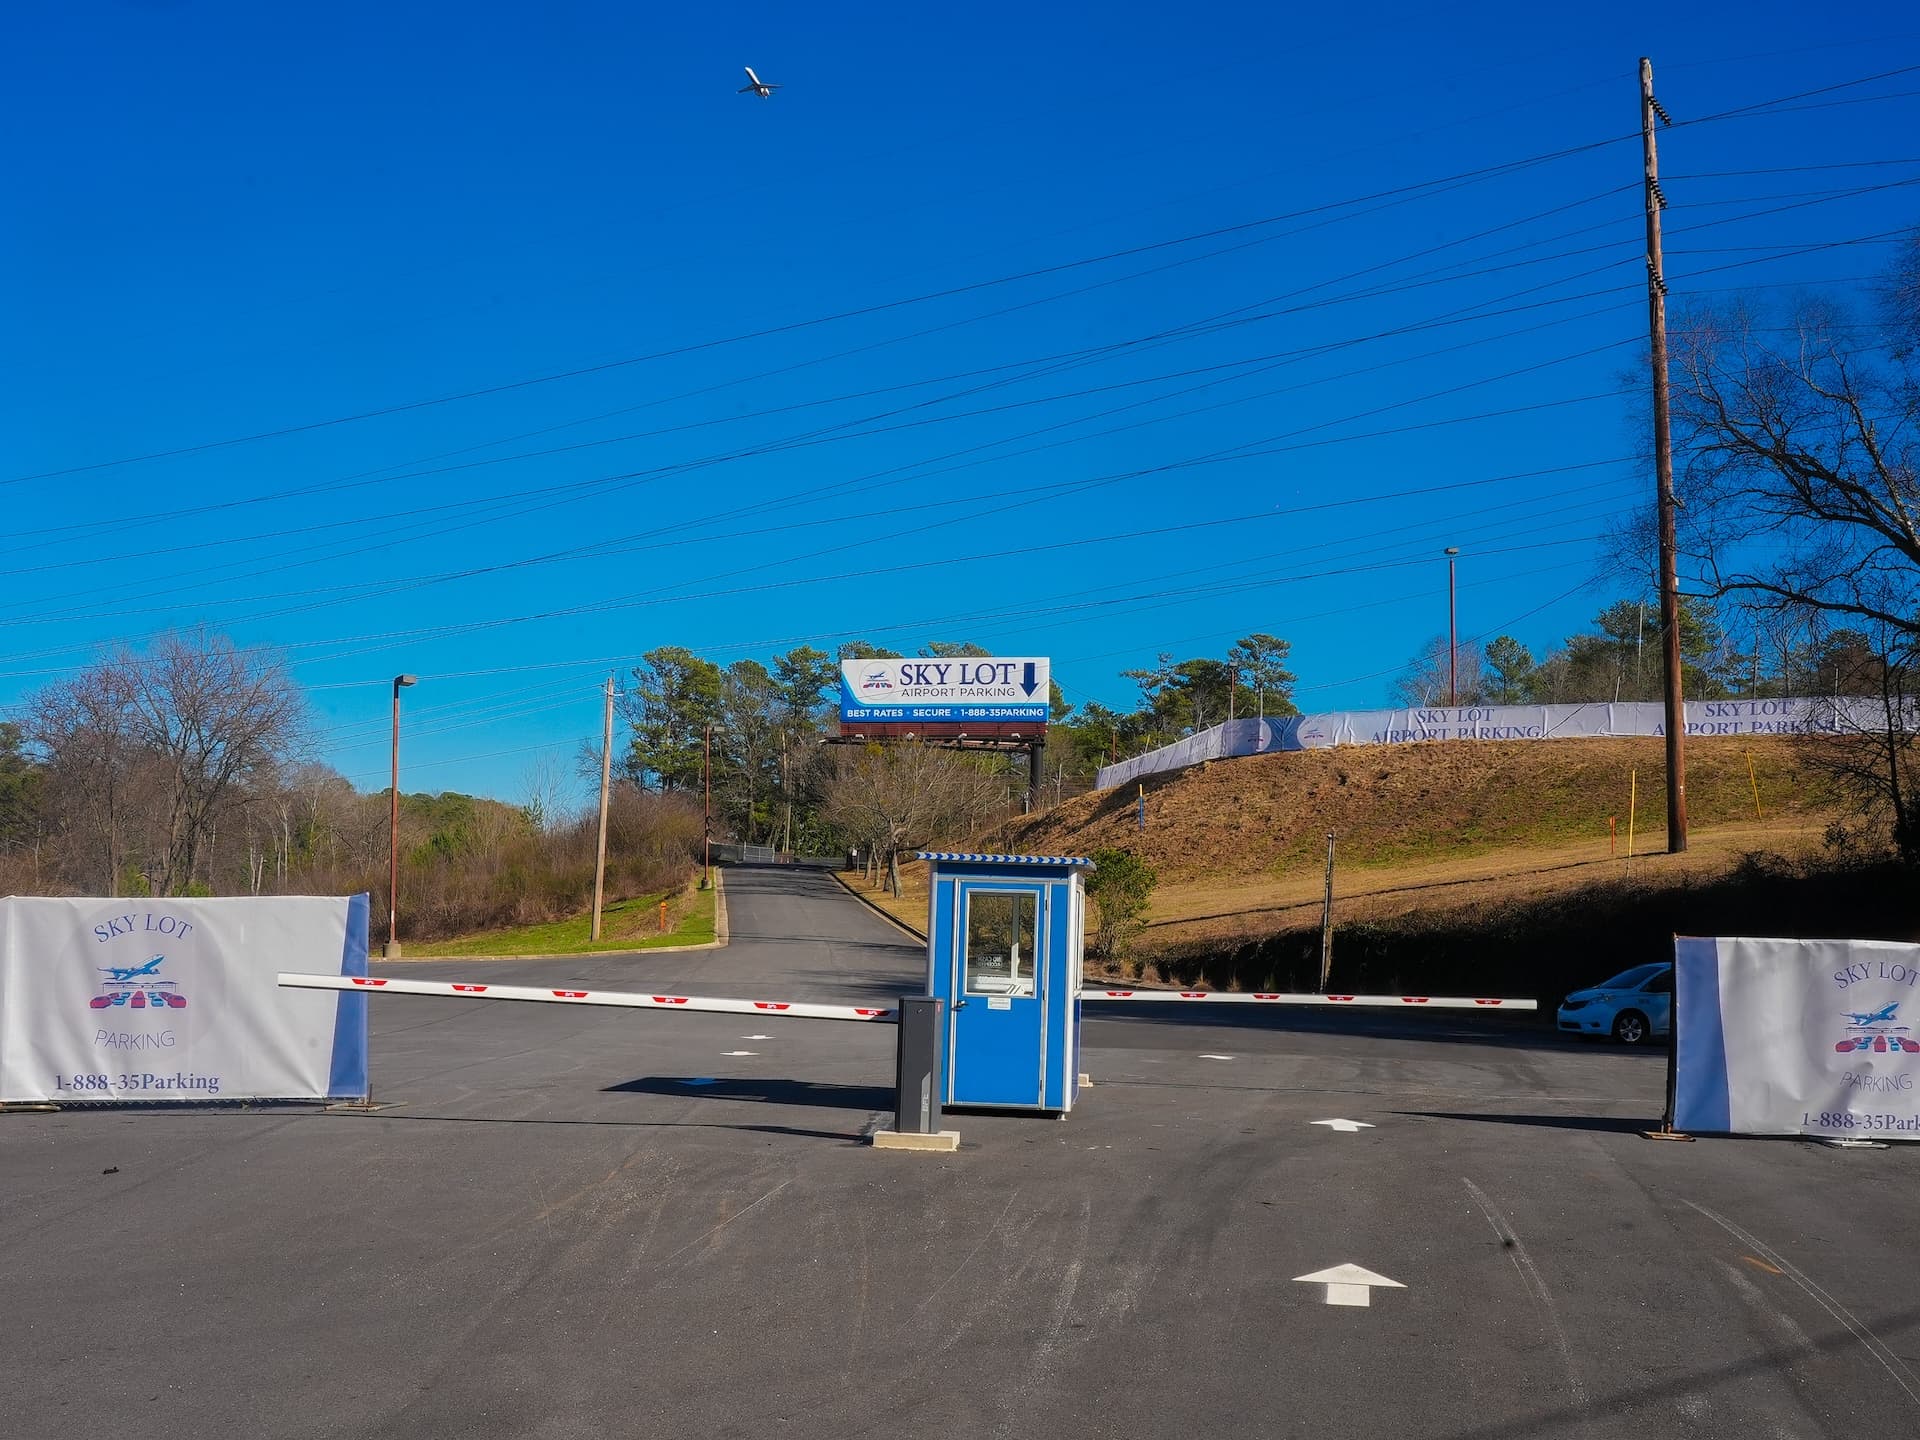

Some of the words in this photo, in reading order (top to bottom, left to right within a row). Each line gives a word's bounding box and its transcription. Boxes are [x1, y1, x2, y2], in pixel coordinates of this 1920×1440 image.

[899, 663, 952, 686] SKY
[959, 662, 1016, 685] LOT
[901, 688, 956, 697] AIRPORT
[960, 687, 1016, 697] PARKING
[847, 709, 871, 717] BEST
[873, 709, 903, 717] RATES
[912, 708, 951, 717] SECURE
[960, 708, 1044, 717] 1-888-35PARKING
[1417, 710, 1451, 723] SKY
[1456, 708, 1495, 722] LOT
[1705, 703, 1742, 717] SKY
[1750, 701, 1795, 715] LOT
[1457, 725, 1541, 739] PARKING
[1652, 722, 1743, 736] APORT
[94, 914, 136, 943] SKY
[144, 914, 192, 940] LOT
[1833, 962, 1871, 989] SKY
[1879, 962, 1920, 986] LOT
[95, 1029, 175, 1050] PARKING
[55, 1073, 220, 1093] 1-888-35Parking
[1840, 1072, 1913, 1092] PARKING
